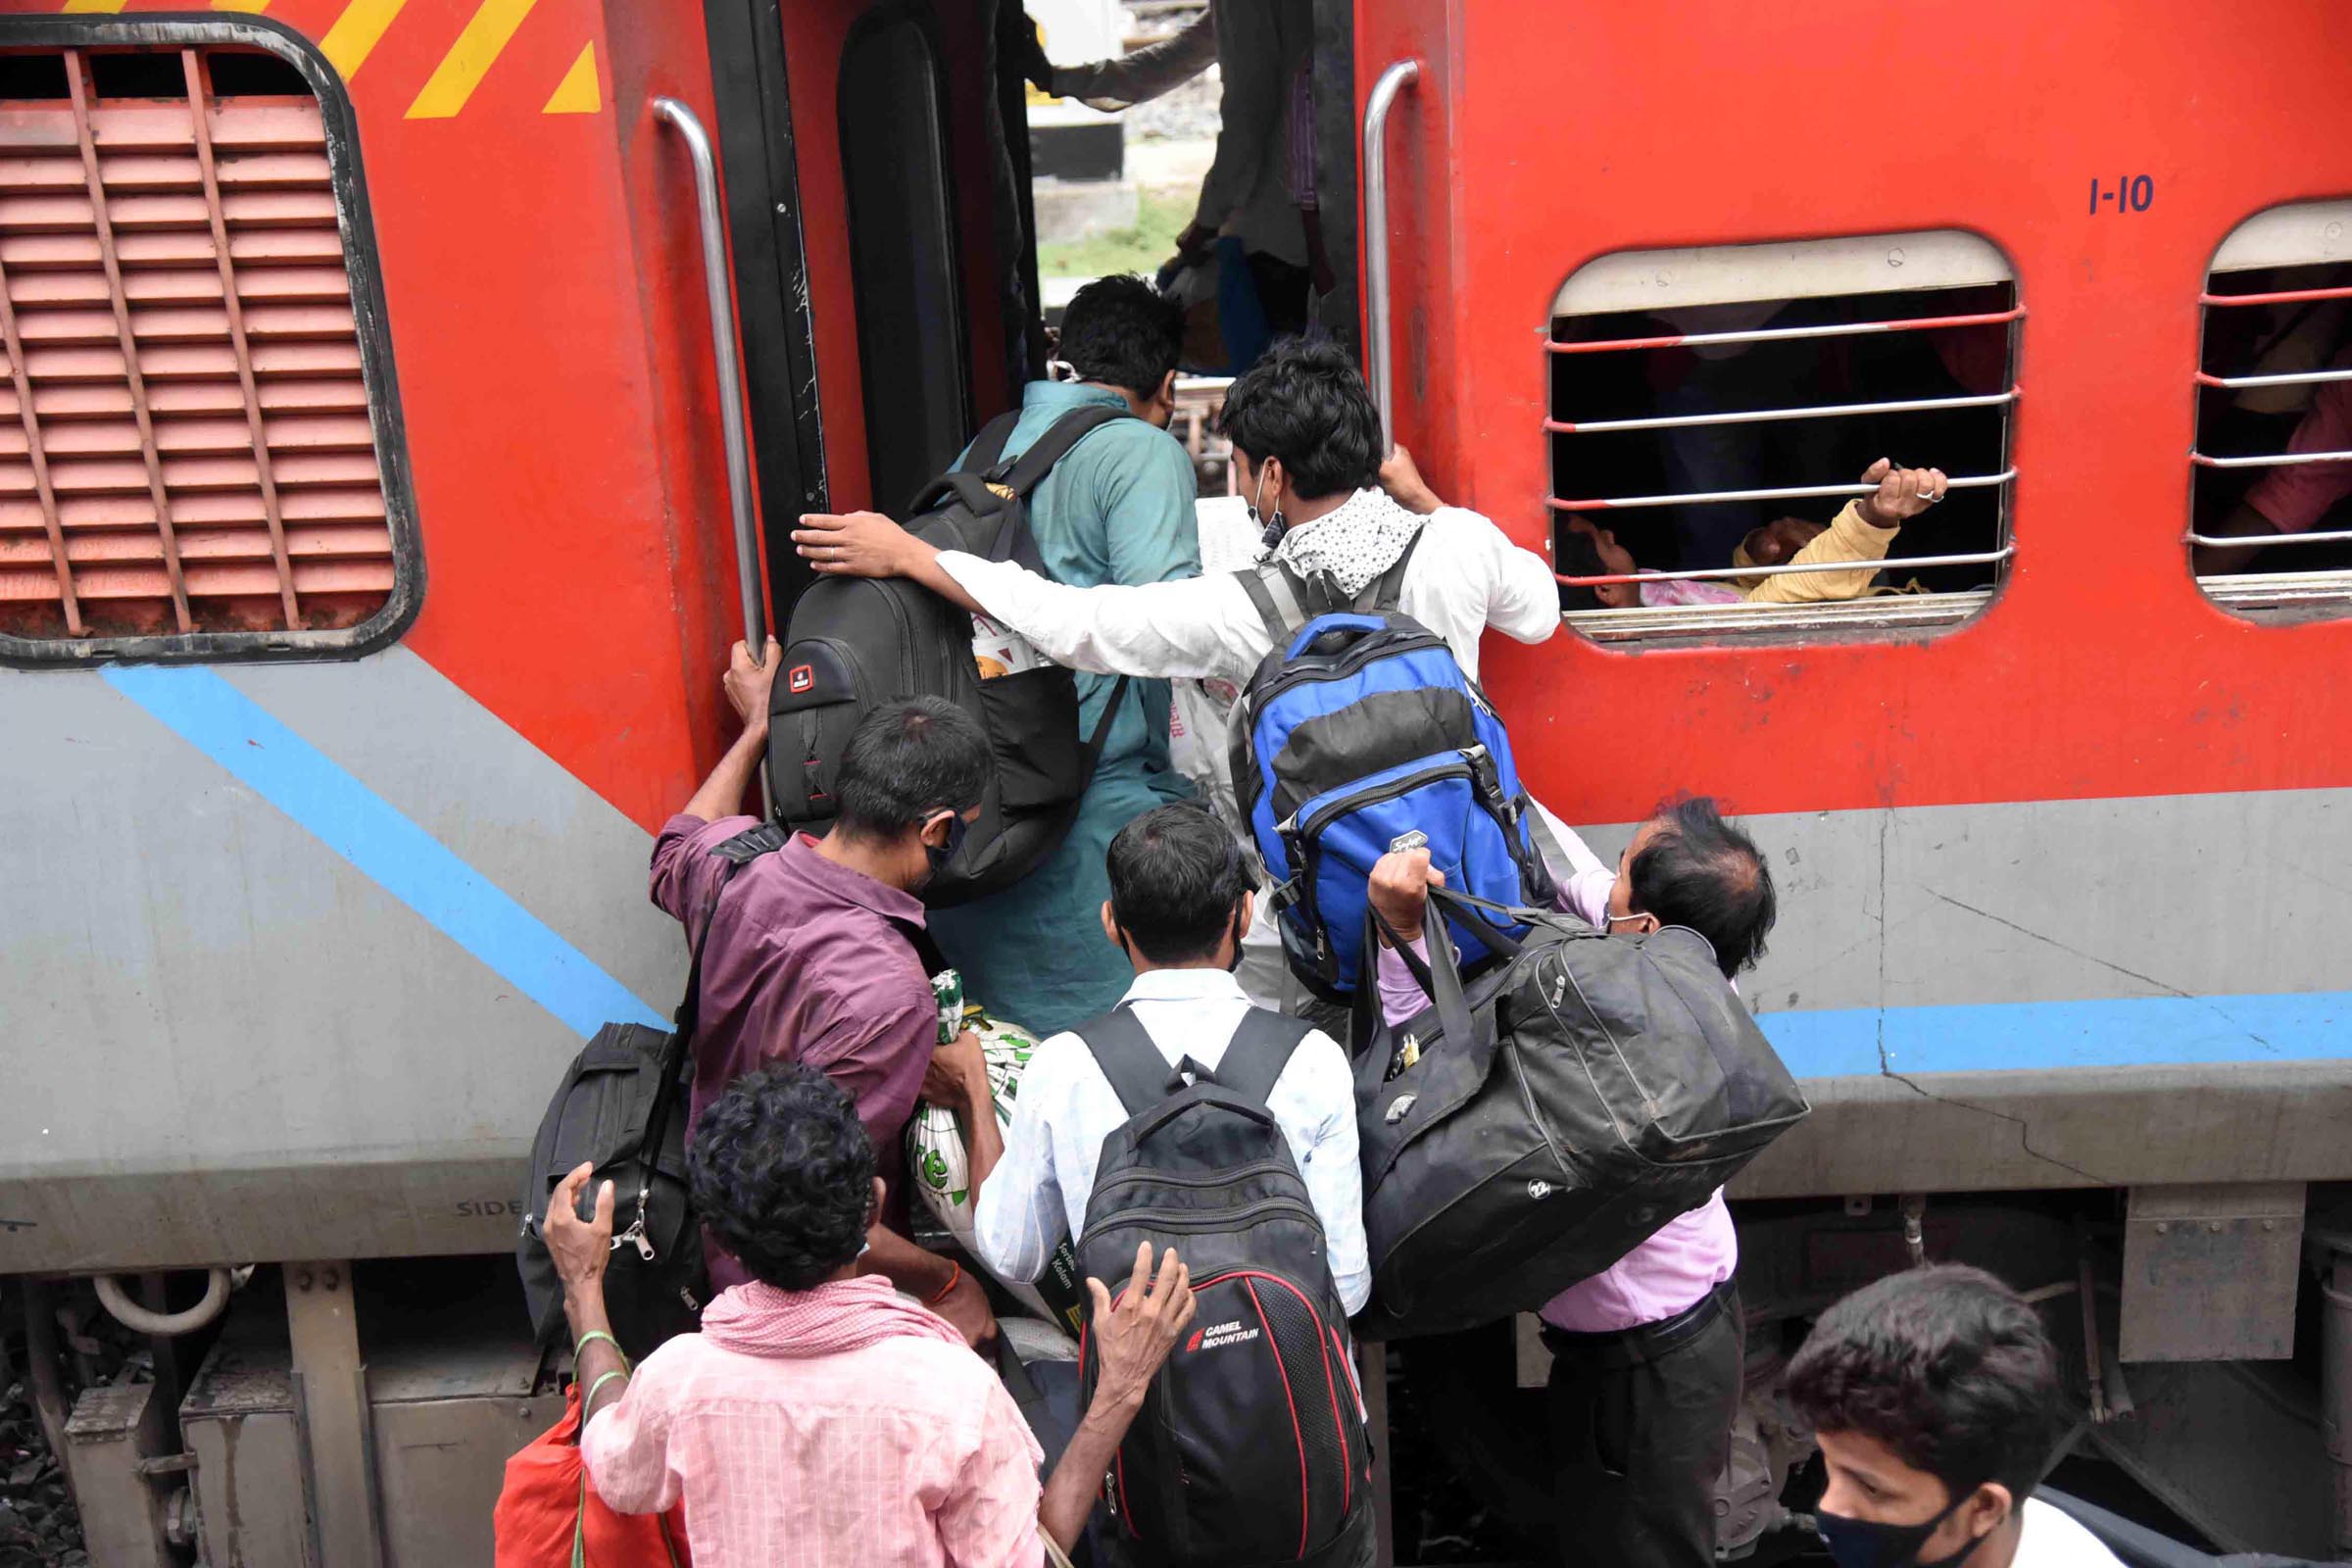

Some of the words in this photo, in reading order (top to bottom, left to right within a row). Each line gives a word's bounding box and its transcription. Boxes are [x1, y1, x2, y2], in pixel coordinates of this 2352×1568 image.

[2089, 174, 2154, 216] 1-10
[456, 1199, 523, 1217] SIDE
[1205, 1320, 1242, 1337] CAMEL
[1201, 1328, 1259, 1349] MOUNTAIN
